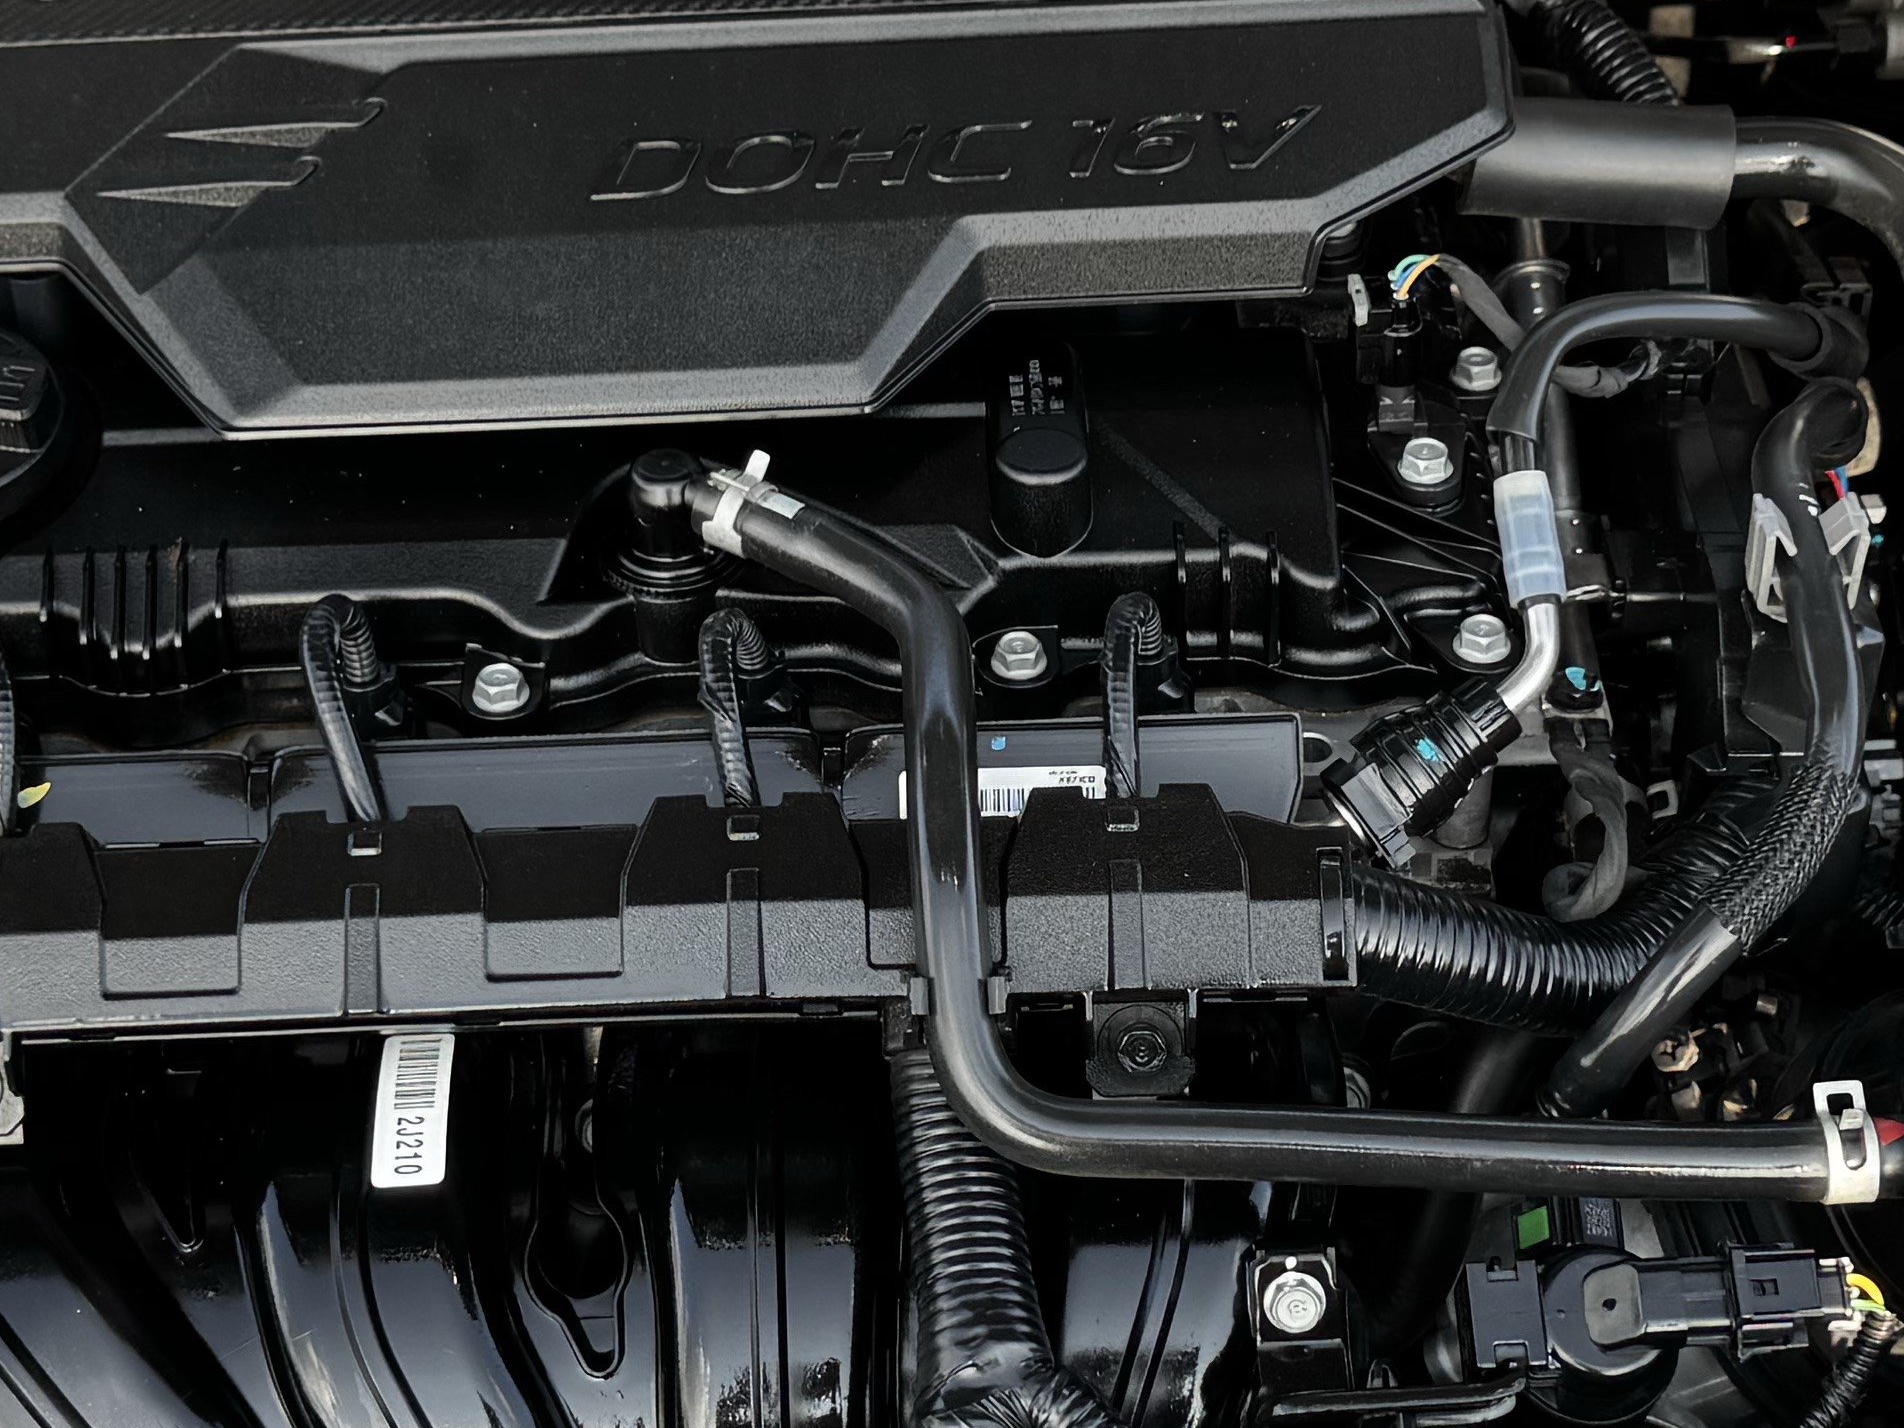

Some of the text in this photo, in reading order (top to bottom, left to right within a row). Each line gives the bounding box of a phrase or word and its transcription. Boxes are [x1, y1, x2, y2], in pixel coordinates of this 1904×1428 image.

[590, 104, 1323, 202] DOHC 16V
[394, 1116, 425, 1175] 2J210
